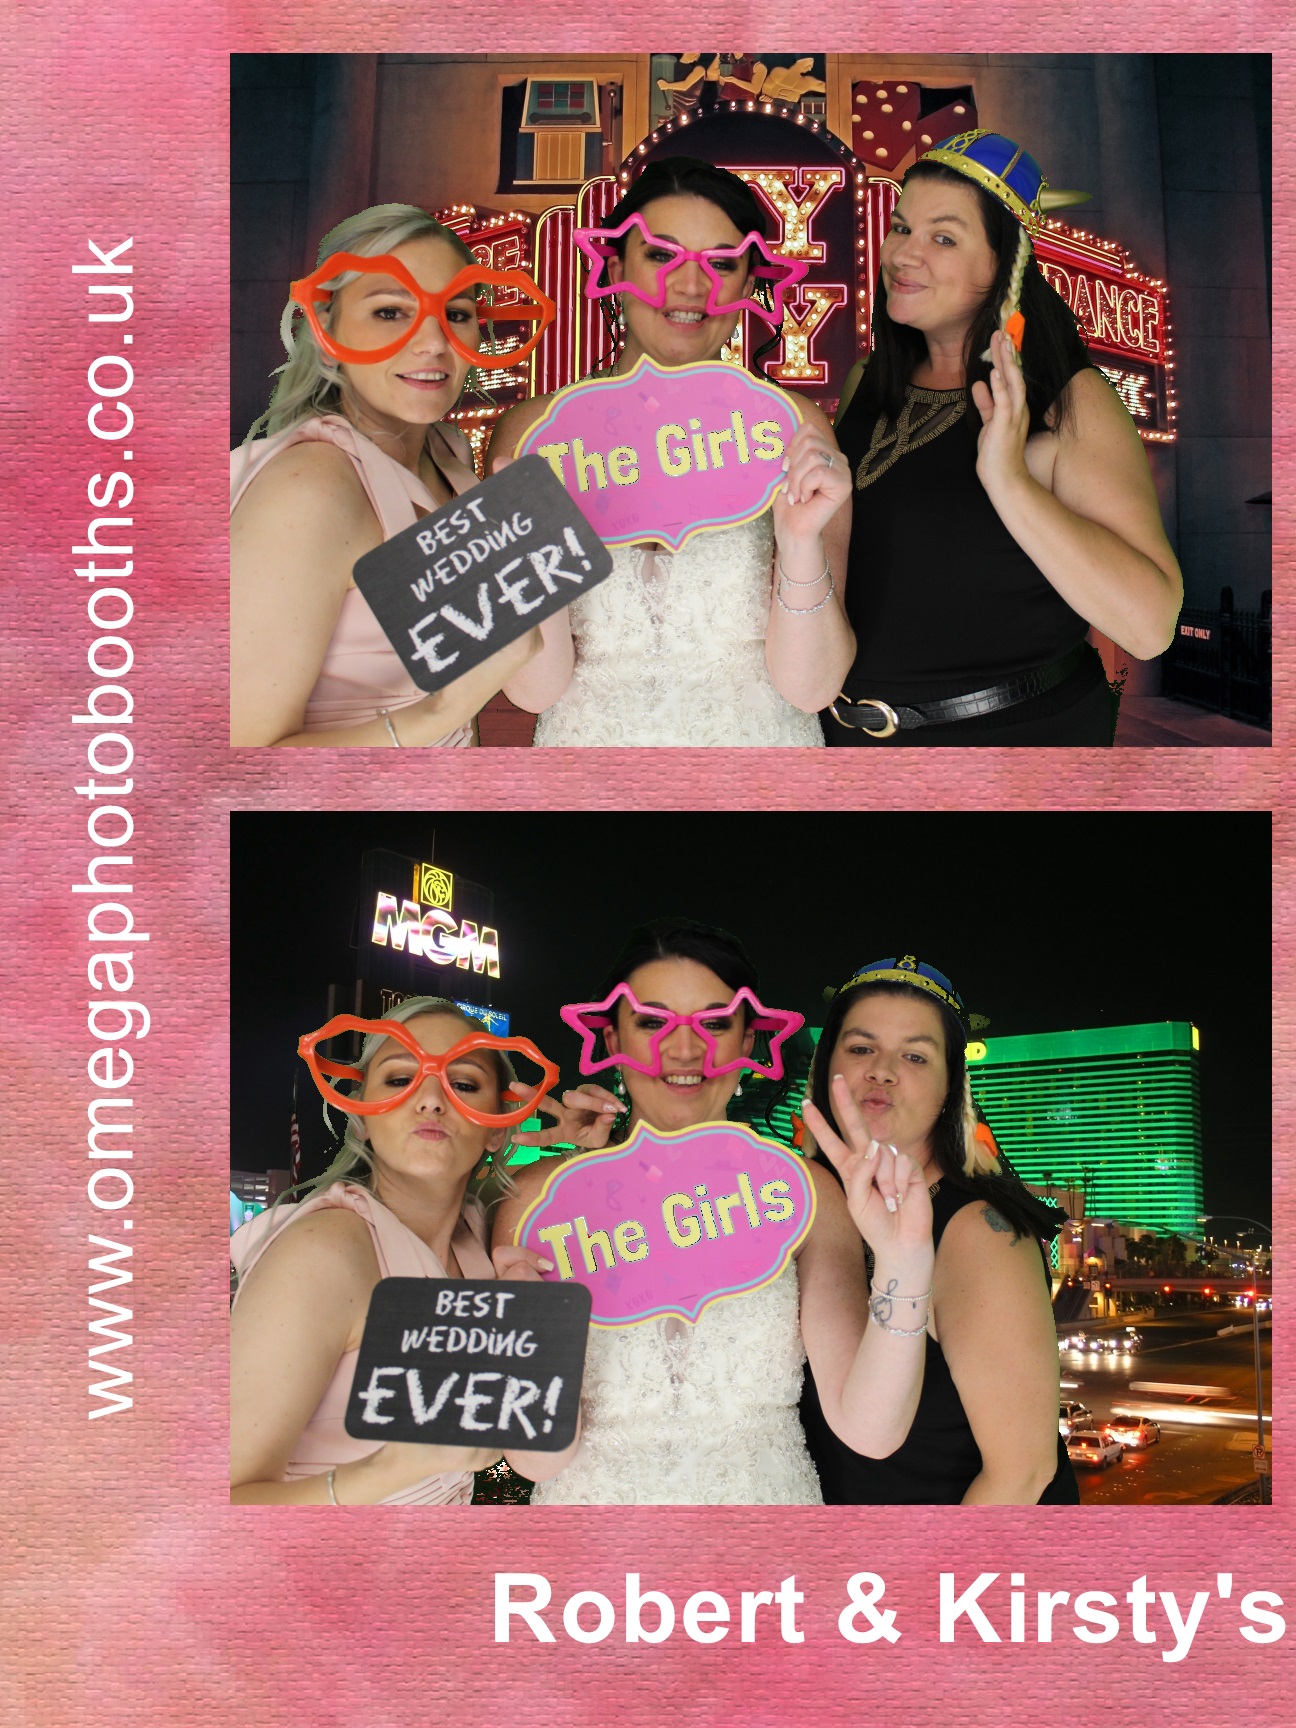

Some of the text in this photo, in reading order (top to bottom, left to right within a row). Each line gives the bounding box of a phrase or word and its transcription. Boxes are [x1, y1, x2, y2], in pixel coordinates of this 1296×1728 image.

[538, 410, 785, 493] The Girls
[415, 497, 487, 556] BEST
[409, 526, 593, 674] EVER!
[1180, 625, 1211, 640] EXIT ONLY
[371, 891, 500, 979] MGM
[539, 1172, 795, 1281] The Girls
[434, 1290, 516, 1320] BEST
[358, 1366, 564, 1440] EVER!
